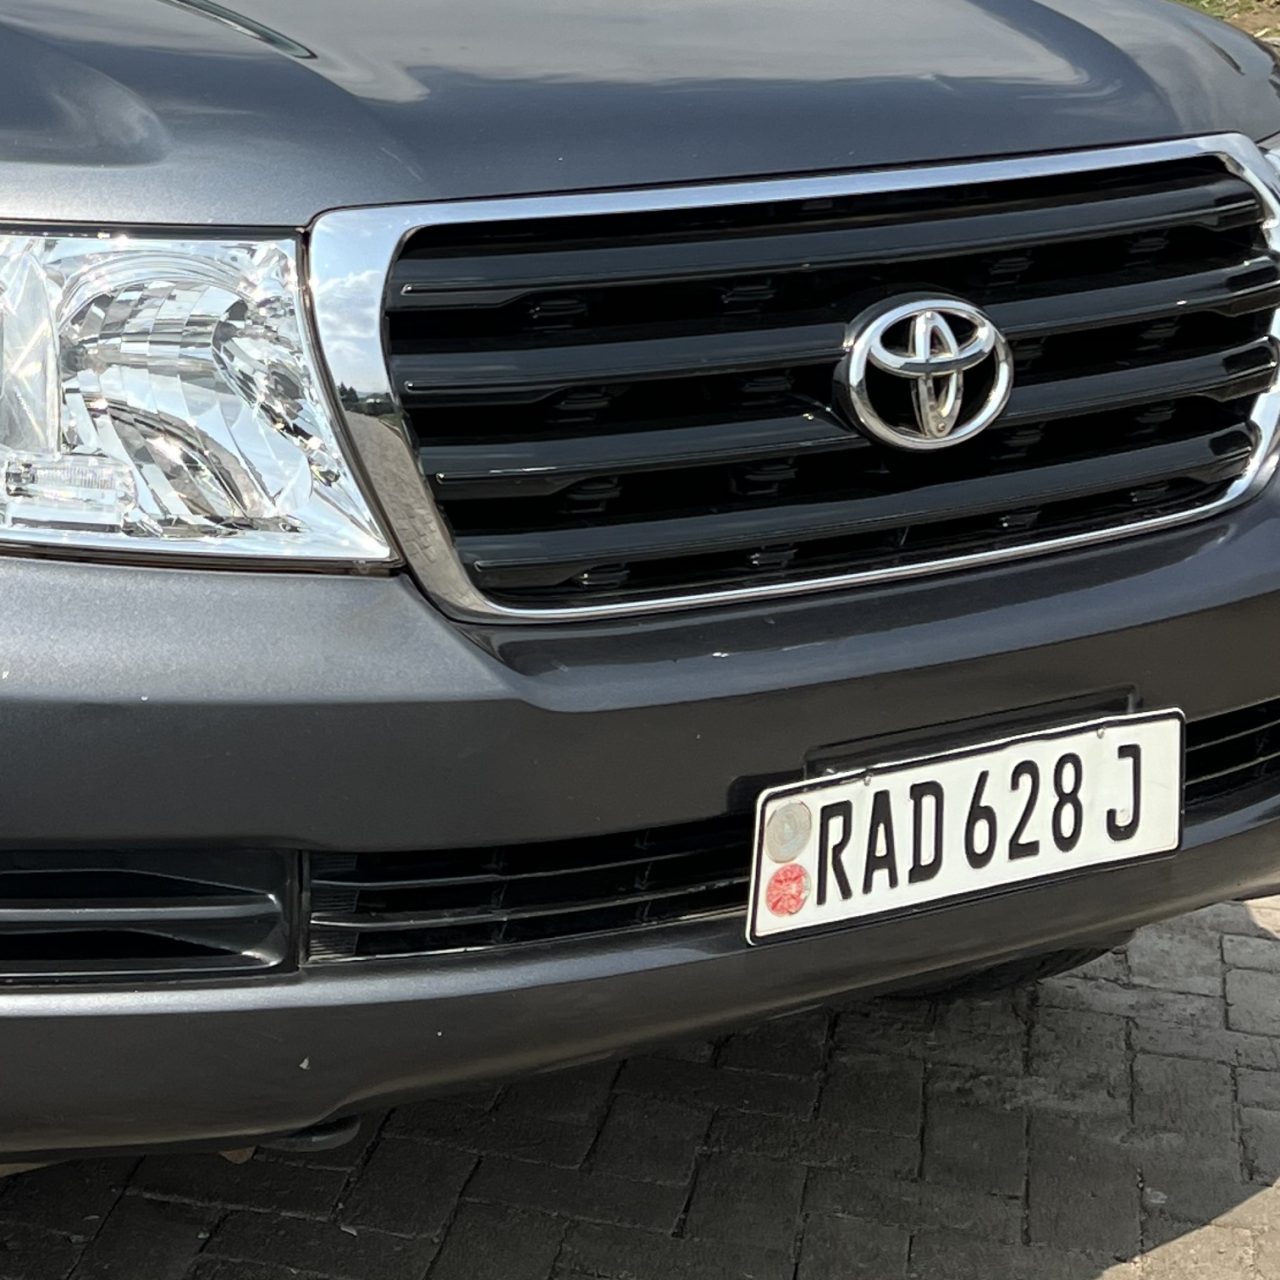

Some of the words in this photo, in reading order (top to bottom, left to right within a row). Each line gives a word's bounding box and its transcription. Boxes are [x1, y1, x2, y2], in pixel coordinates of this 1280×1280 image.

[816, 781, 944, 906] RAD
[964, 752, 1083, 869] 628
[1106, 744, 1141, 842] J
